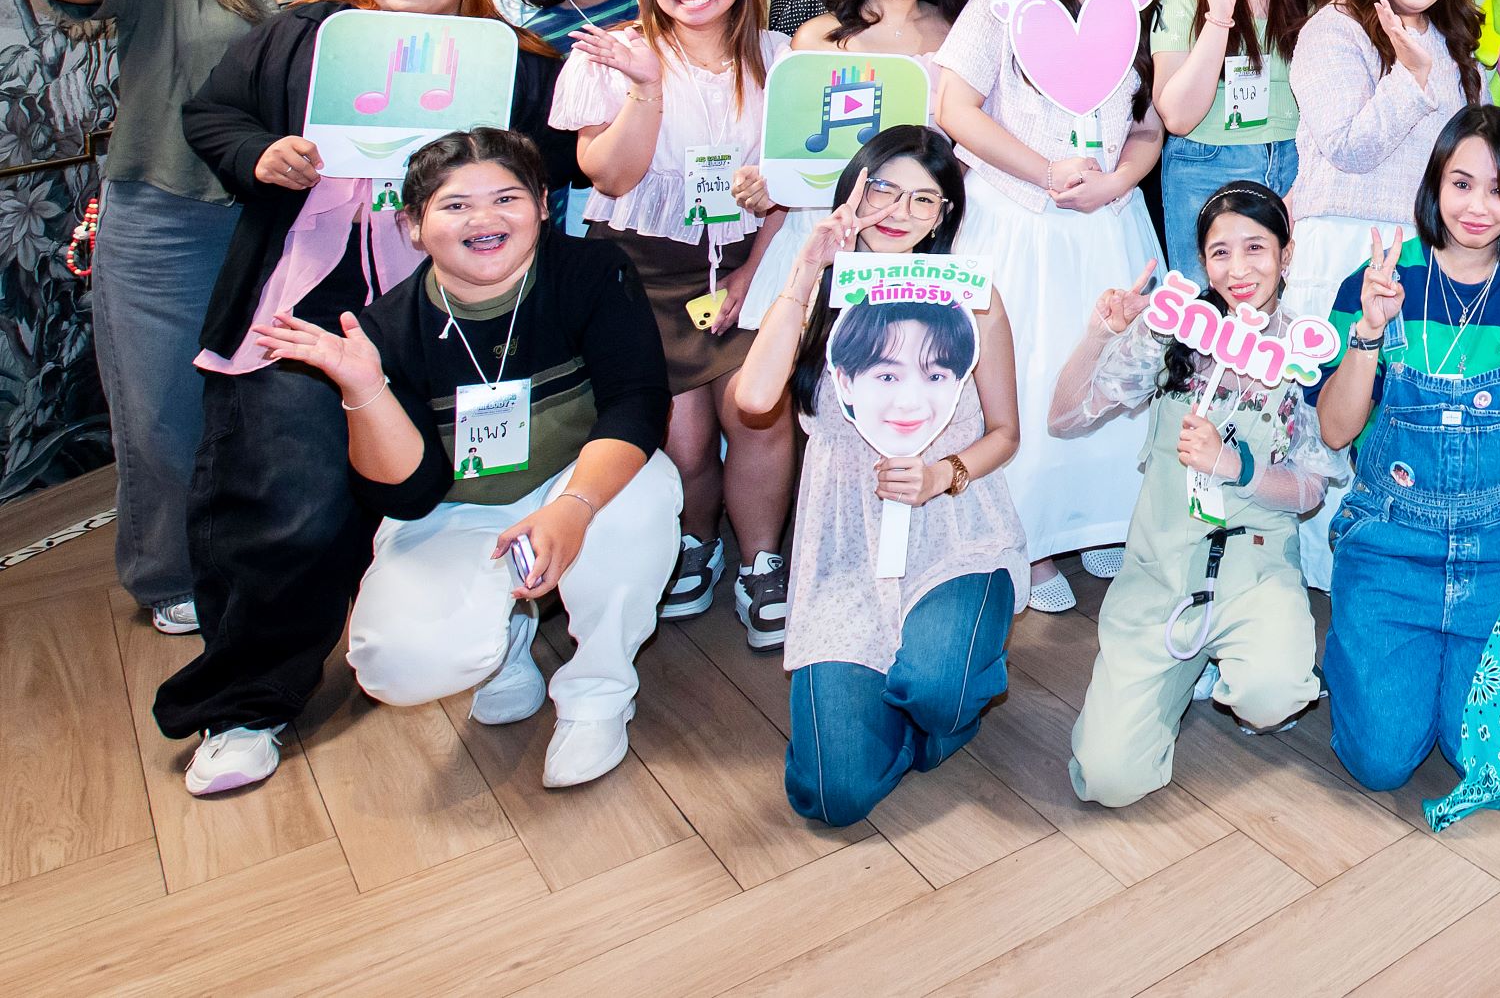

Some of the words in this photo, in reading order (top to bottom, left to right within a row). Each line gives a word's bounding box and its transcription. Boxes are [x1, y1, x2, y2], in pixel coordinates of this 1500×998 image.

[871, 279, 952, 302] ที่แท้จริง
[471, 420, 509, 443] แพร
